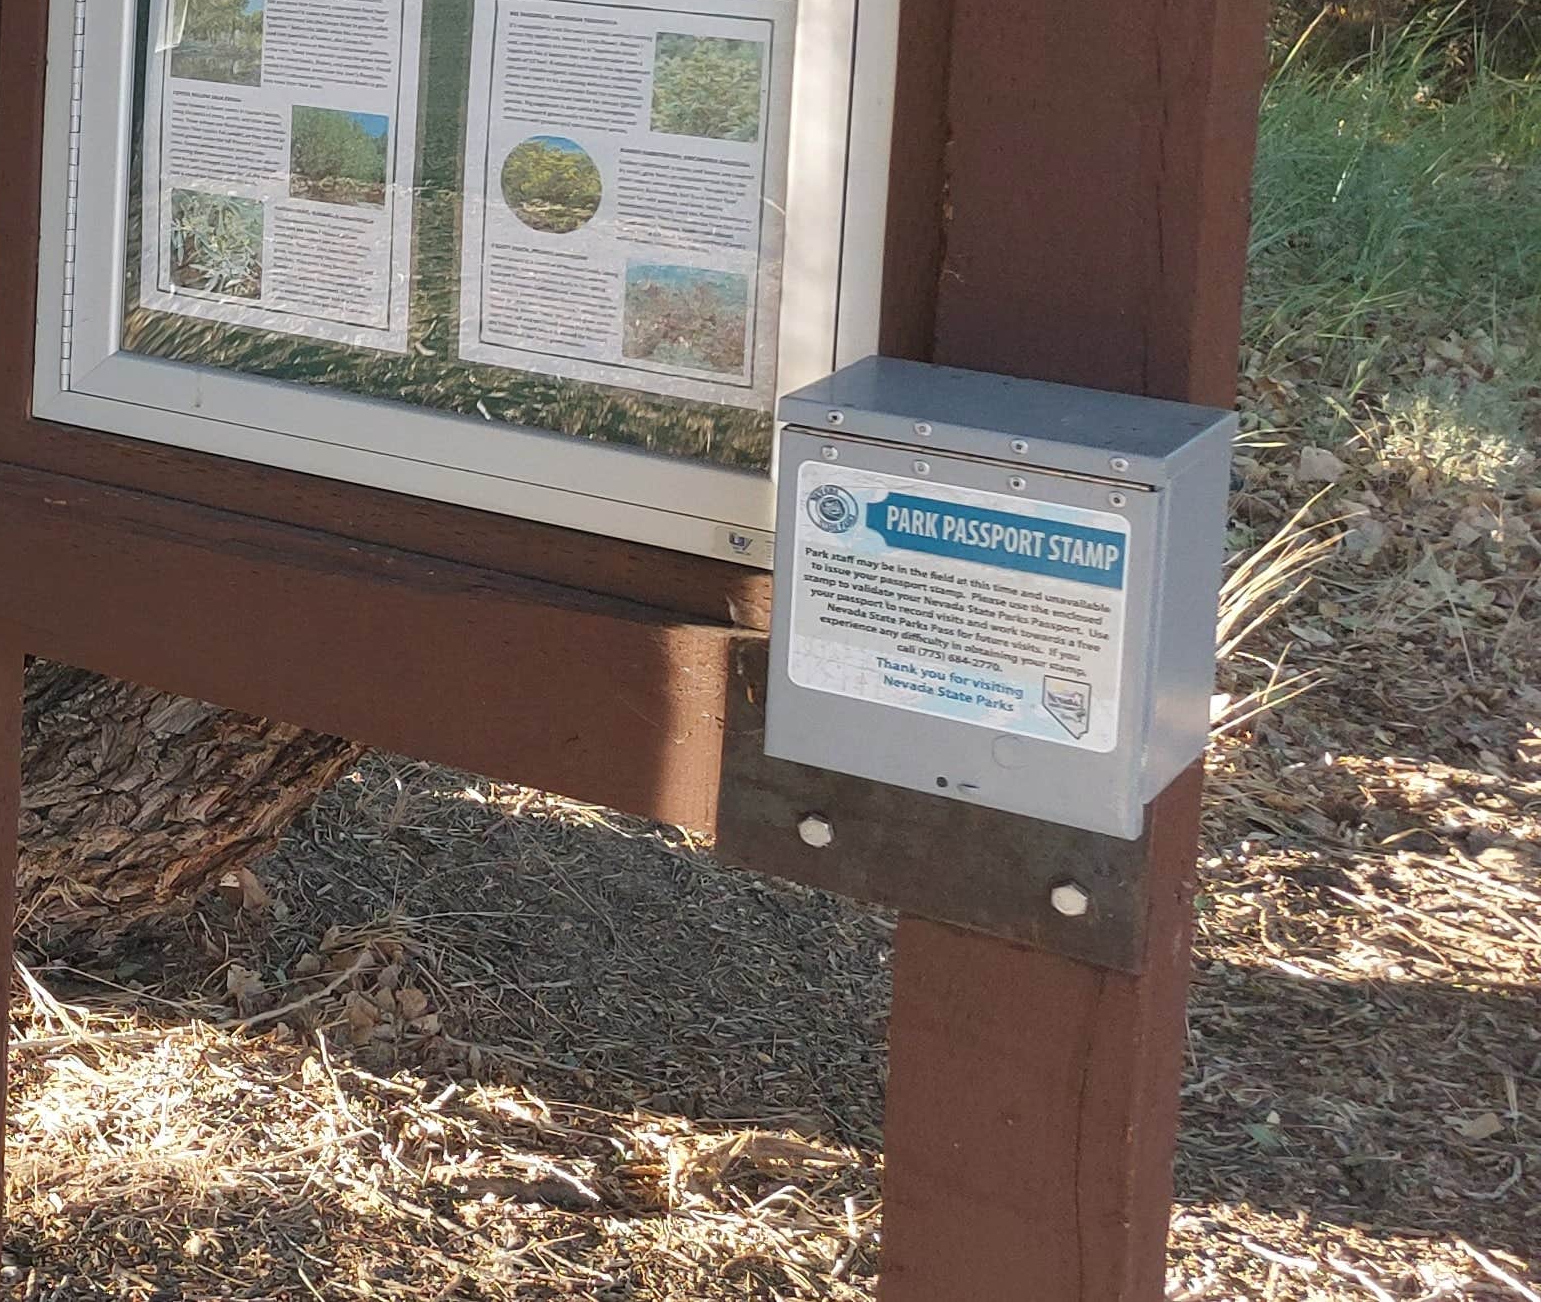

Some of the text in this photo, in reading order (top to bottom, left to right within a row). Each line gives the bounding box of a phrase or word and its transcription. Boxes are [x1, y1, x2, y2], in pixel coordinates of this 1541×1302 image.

[886, 505, 938, 538] PARK
[942, 515, 1044, 556] PASSPORT
[1048, 534, 1118, 569] STAMP
[803, 573, 836, 587] stamp
[837, 579, 850, 589] to
[851, 583, 894, 597] validate
[895, 591, 921, 603] your
[923, 595, 965, 611] Nevada
[966, 604, 996, 617] State
[997, 610, 1029, 624] Parks
[1088, 627, 1109, 640] Use
[804, 546, 829, 559] Park
[830, 553, 855, 564] staff
[855, 558, 879, 570] may
[880, 561, 895, 572] be
[896, 563, 907, 574] in
[910, 567, 928, 578] the
[955, 577, 968, 586] at
[969, 578, 991, 590] this
[992, 583, 1018, 595] time
[1019, 589, 1042, 600] and
[1044, 594, 1111, 613] unavailable
[810, 561, 823, 571] to
[823, 562, 851, 576] issue
[852, 570, 878, 581] your
[879, 576, 927, 591] passport
[970, 591, 1007, 607] Please
[1008, 601, 1028, 611] use
[1027, 603, 1049, 615] the
[1051, 609, 1103, 625] enclosed
[809, 588, 1101, 652] your passport to record visits and work towards a free
[819, 616, 877, 633] experience
[878, 627, 899, 639] any
[900, 631, 949, 649] difficulty
[950, 640, 962, 650] in
[963, 644, 1018, 664] obtaining
[1019, 656, 1047, 667] your
[826, 602, 867, 618] Nevada
[868, 610, 896, 624] State
[898, 616, 928, 630] Parks
[930, 623, 955, 636] Pass
[956, 628, 973, 639] for
[1047, 647, 1057, 657] If
[1057, 651, 1081, 662] you
[876, 656, 1023, 699] Thank you for visiting
[883, 674, 1013, 711] Nevada State Parks
